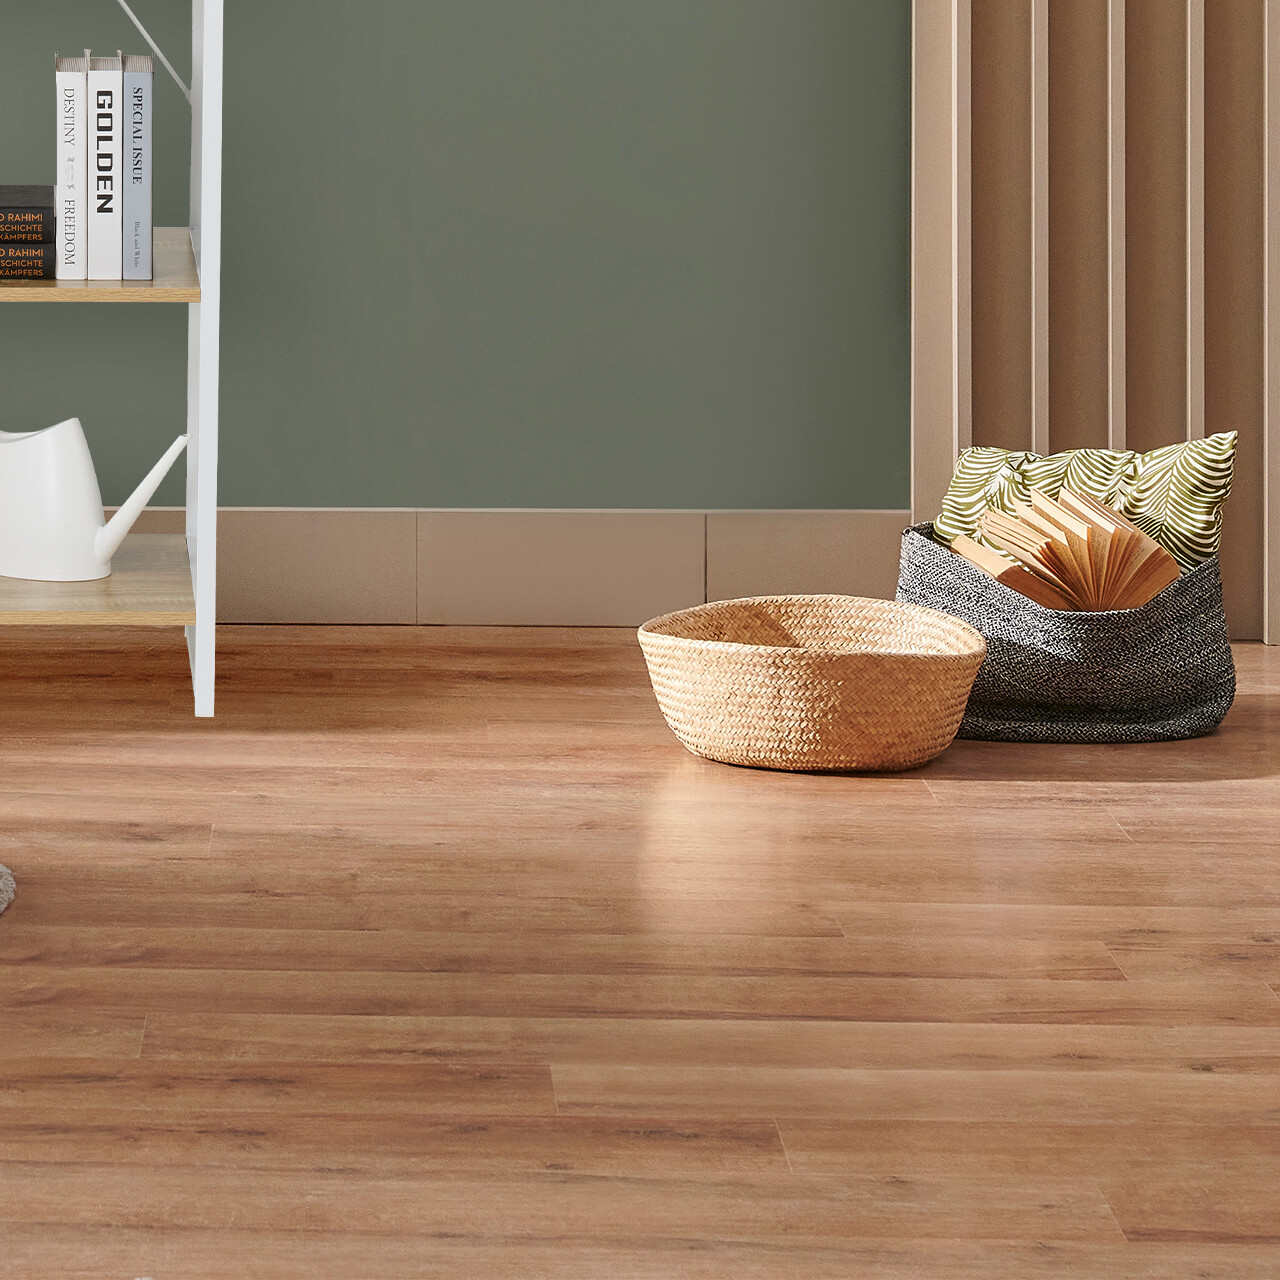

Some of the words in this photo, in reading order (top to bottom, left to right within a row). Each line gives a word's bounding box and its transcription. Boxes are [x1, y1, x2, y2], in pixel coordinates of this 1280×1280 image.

[64, 88, 75, 146] DESTINY
[132, 87, 143, 144] SPECIAL
[96, 90, 113, 213] GOLDEN
[132, 147, 143, 185] ISSUE
[7, 213, 43, 222] RAHIMI
[64, 199, 76, 265] FREEDOM
[8, 248, 44, 257] RAHIMI
